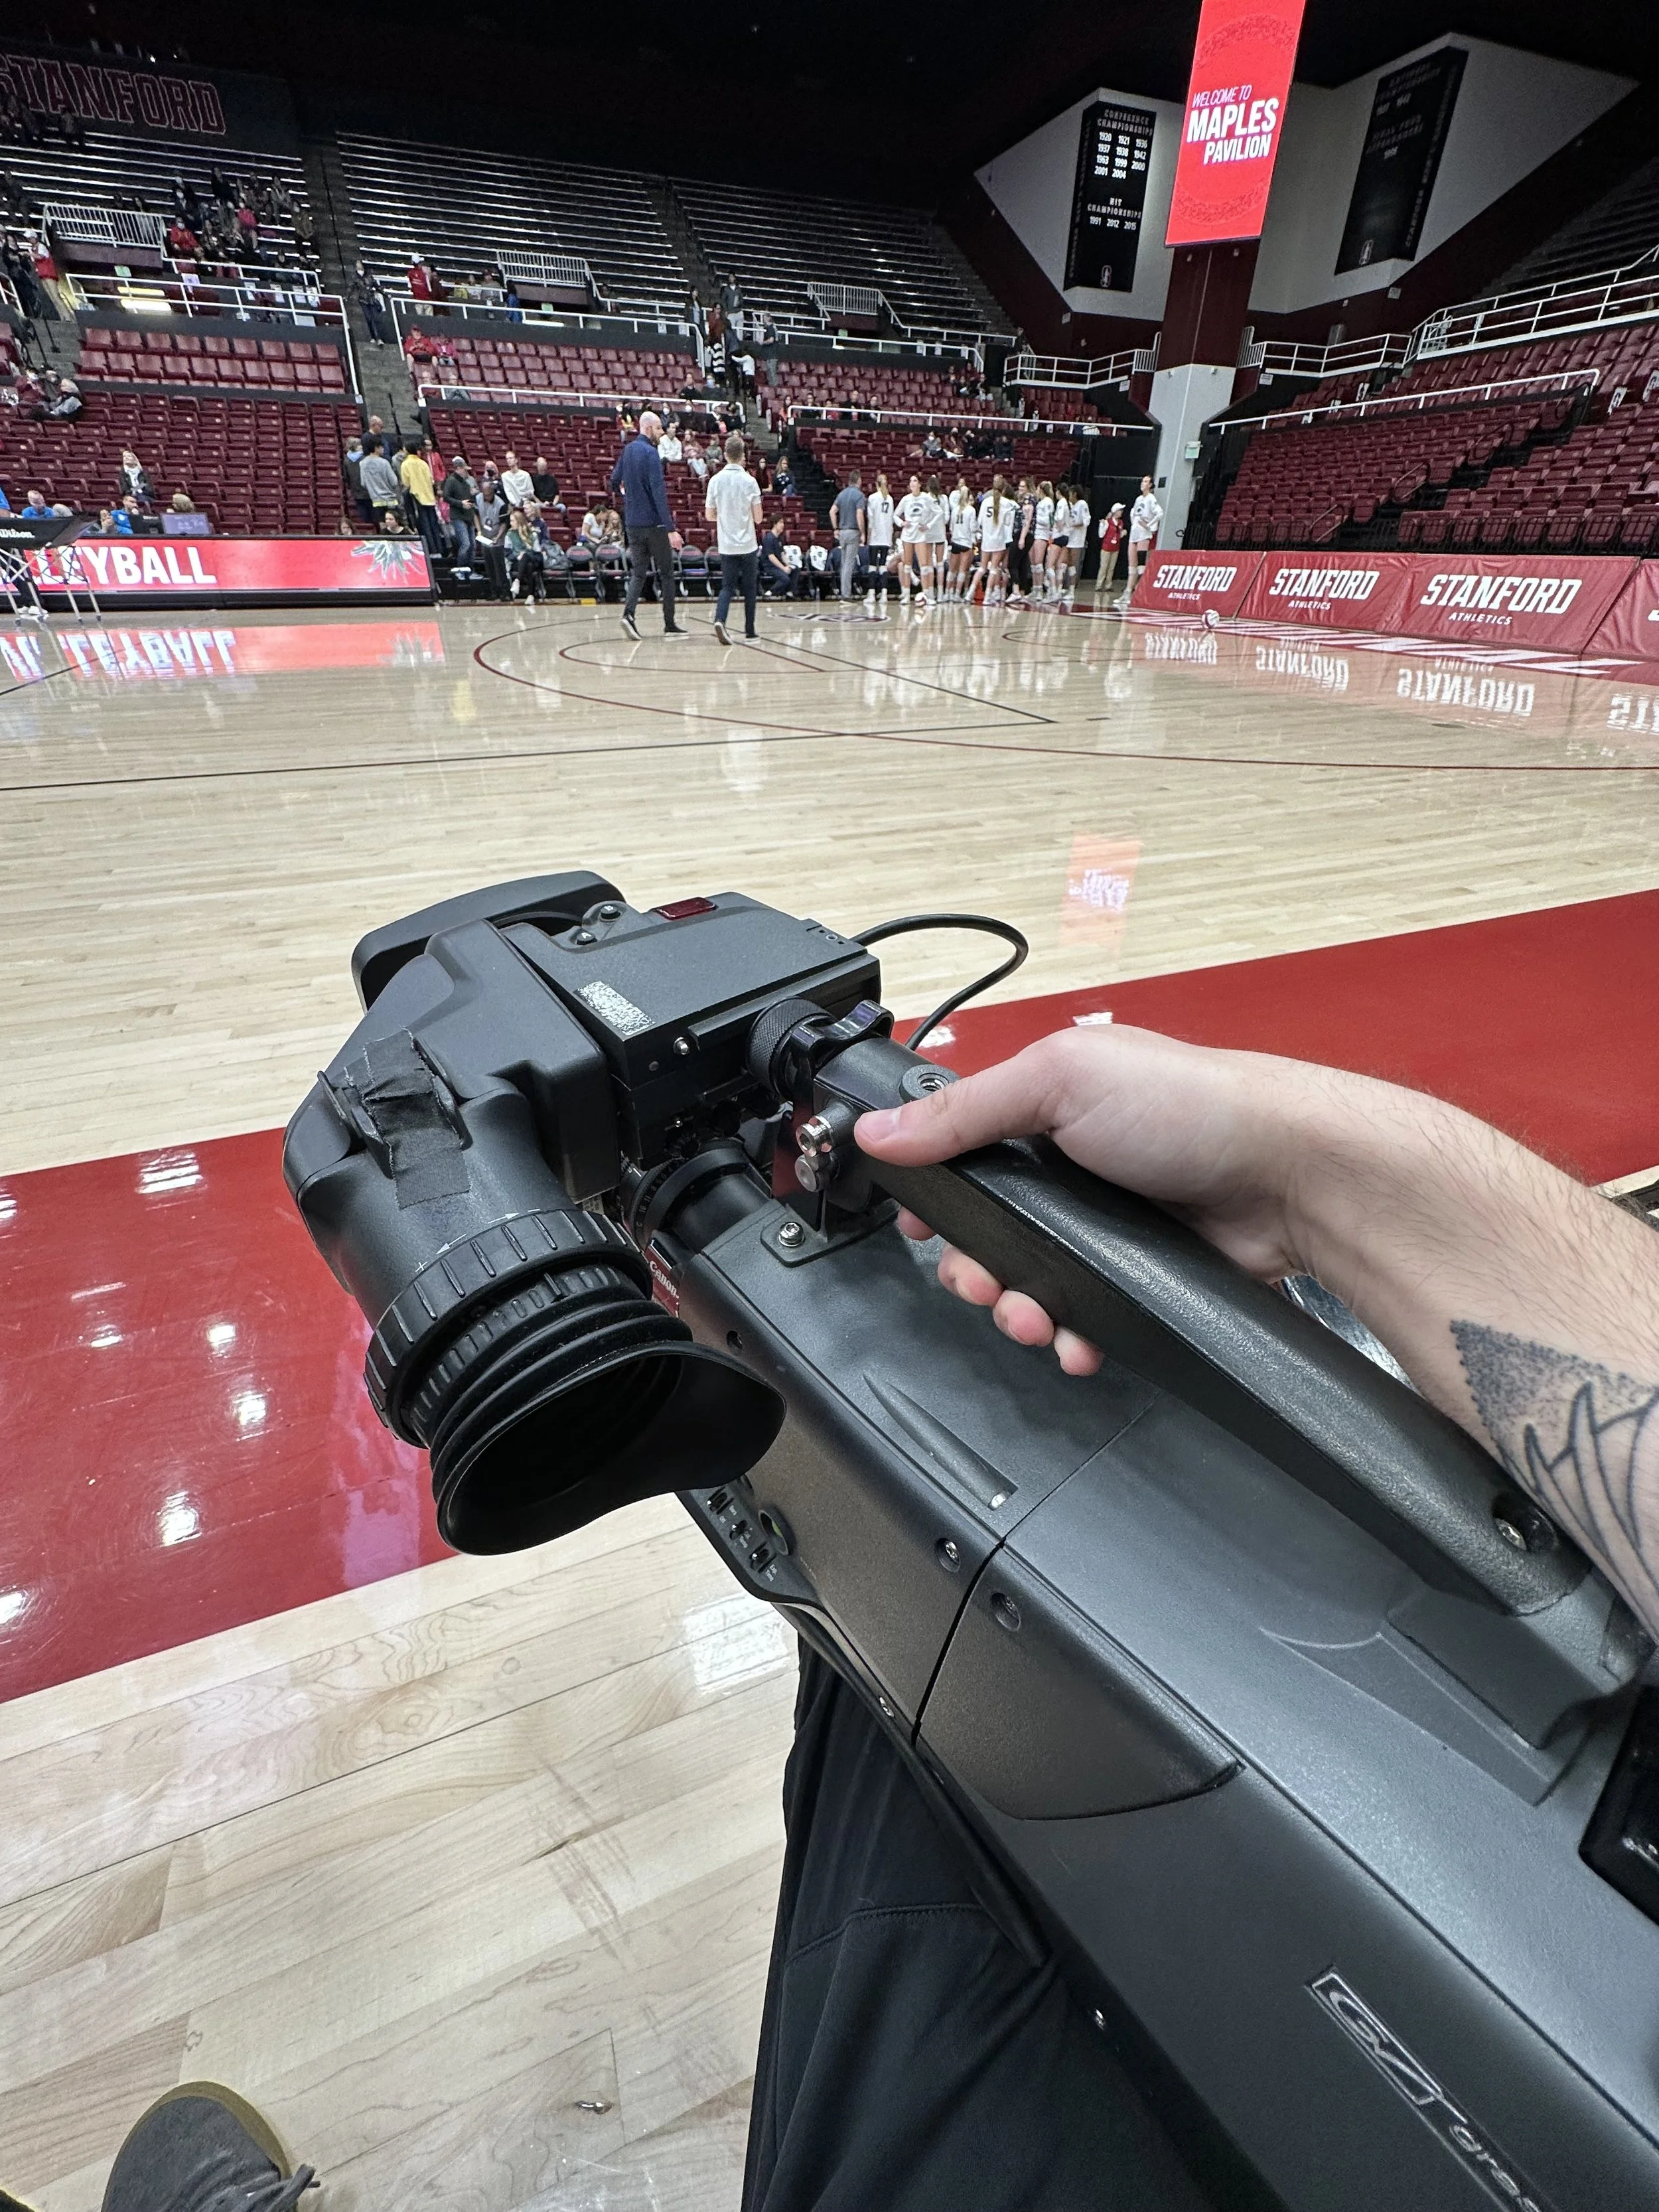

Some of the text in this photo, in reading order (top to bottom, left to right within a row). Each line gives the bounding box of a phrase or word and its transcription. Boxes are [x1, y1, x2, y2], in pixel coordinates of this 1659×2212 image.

[1192, 84, 1253, 108] WELCOME TO
[1097, 118, 1153, 136] CHAMPIONSHIPS
[1187, 98, 1279, 143] MAPLES
[1099, 131, 1112, 142] 1920
[1118, 135, 1130, 145] 1921
[1098, 143, 1147, 160] 1937 1938 1942
[1203, 133, 1272, 165] PAVILION
[1094, 165, 1127, 179] 2001 2004
[1115, 157, 1127, 168] 1999
[1131, 160, 1146, 171] 2000
[1087, 203, 1142, 219] CHAMPIONSHIPS
[1090, 216, 1137, 231] 1991 2012 2015
[881, 502, 889, 514] 17
[986, 506, 993, 518] 5
[1153, 564, 1238, 592] STANFORD
[1269, 568, 1380, 600] STANFORD
[1167, 592, 1201, 601] ATHLETICS
[1420, 574, 1583, 615] STANFORD
[1288, 600, 1331, 611] ATHLETICS
[1448, 612, 1513, 626] ATHLETICS
[649, 1261, 677, 1297] Canon
